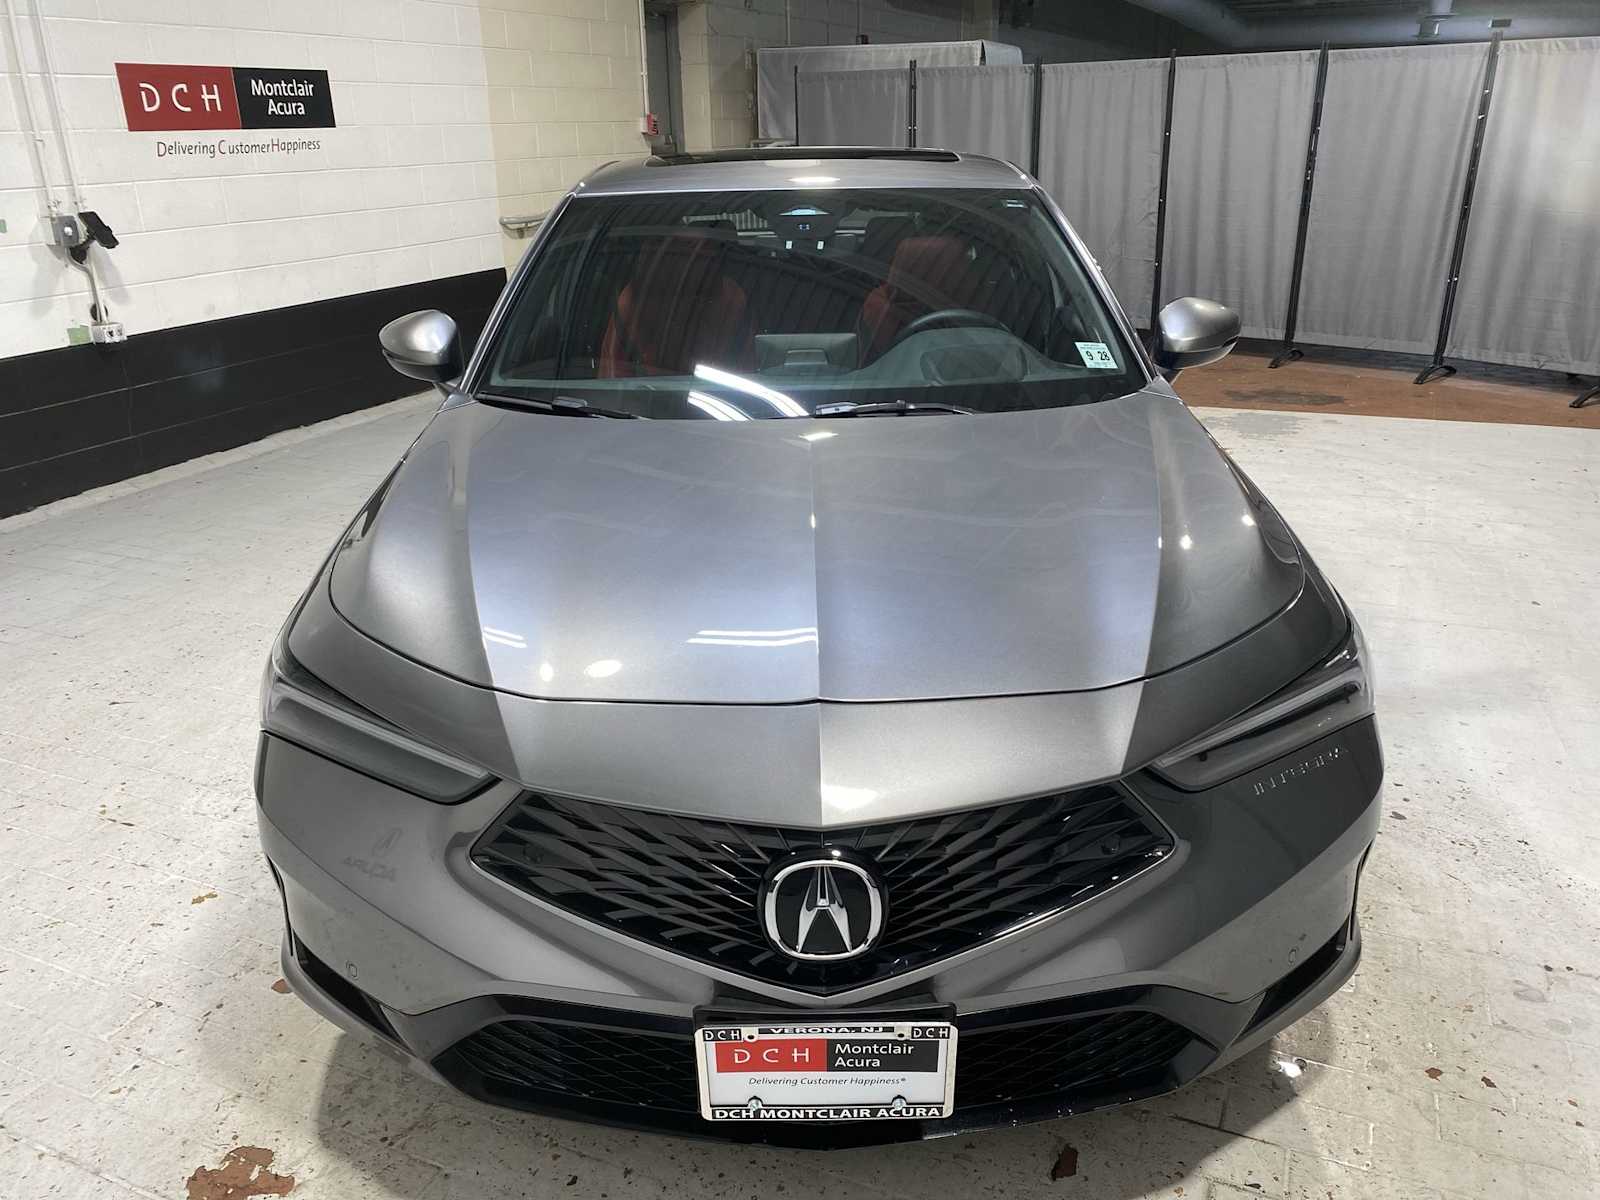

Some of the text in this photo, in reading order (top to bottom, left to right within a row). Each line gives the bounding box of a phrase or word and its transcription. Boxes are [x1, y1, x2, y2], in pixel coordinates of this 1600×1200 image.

[251, 79, 314, 98] Montclair
[267, 98, 306, 116] Acura
[156, 138, 321, 158] Delivering Customer Happiness
[1086, 351, 1111, 361] 9 28
[704, 1030, 741, 1041] DCH
[912, 1028, 950, 1039] DCH
[835, 1043, 914, 1056] Montclair
[835, 1057, 881, 1068] Acura
[748, 1077, 797, 1087] Delivering
[800, 1077, 847, 1085] Customer
[715, 1107, 941, 1119] DCH MONTCLAIR ACURA
